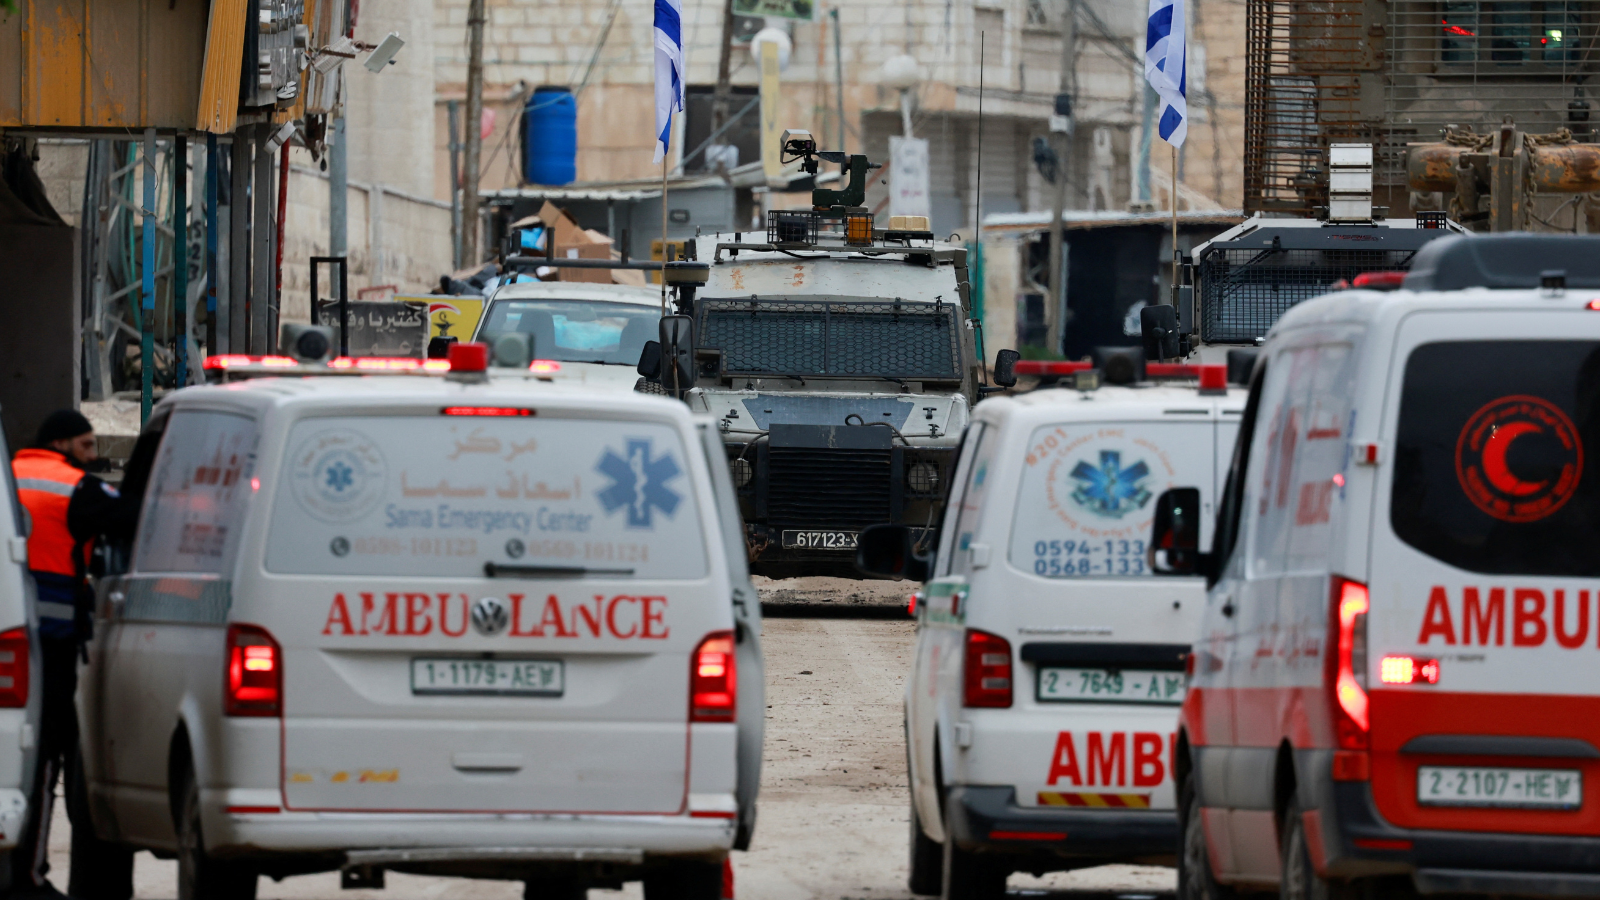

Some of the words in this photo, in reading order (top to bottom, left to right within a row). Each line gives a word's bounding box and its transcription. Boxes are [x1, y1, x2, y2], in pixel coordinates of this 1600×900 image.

[447, 425, 537, 462] مركز
[385, 503, 433, 529] Sama
[438, 504, 531, 534] Emergency
[536, 506, 593, 532] Center
[322, 592, 669, 640] AMBULANCE
[1417, 585, 1600, 650] AMBU
[1047, 731, 1178, 788] AMB
